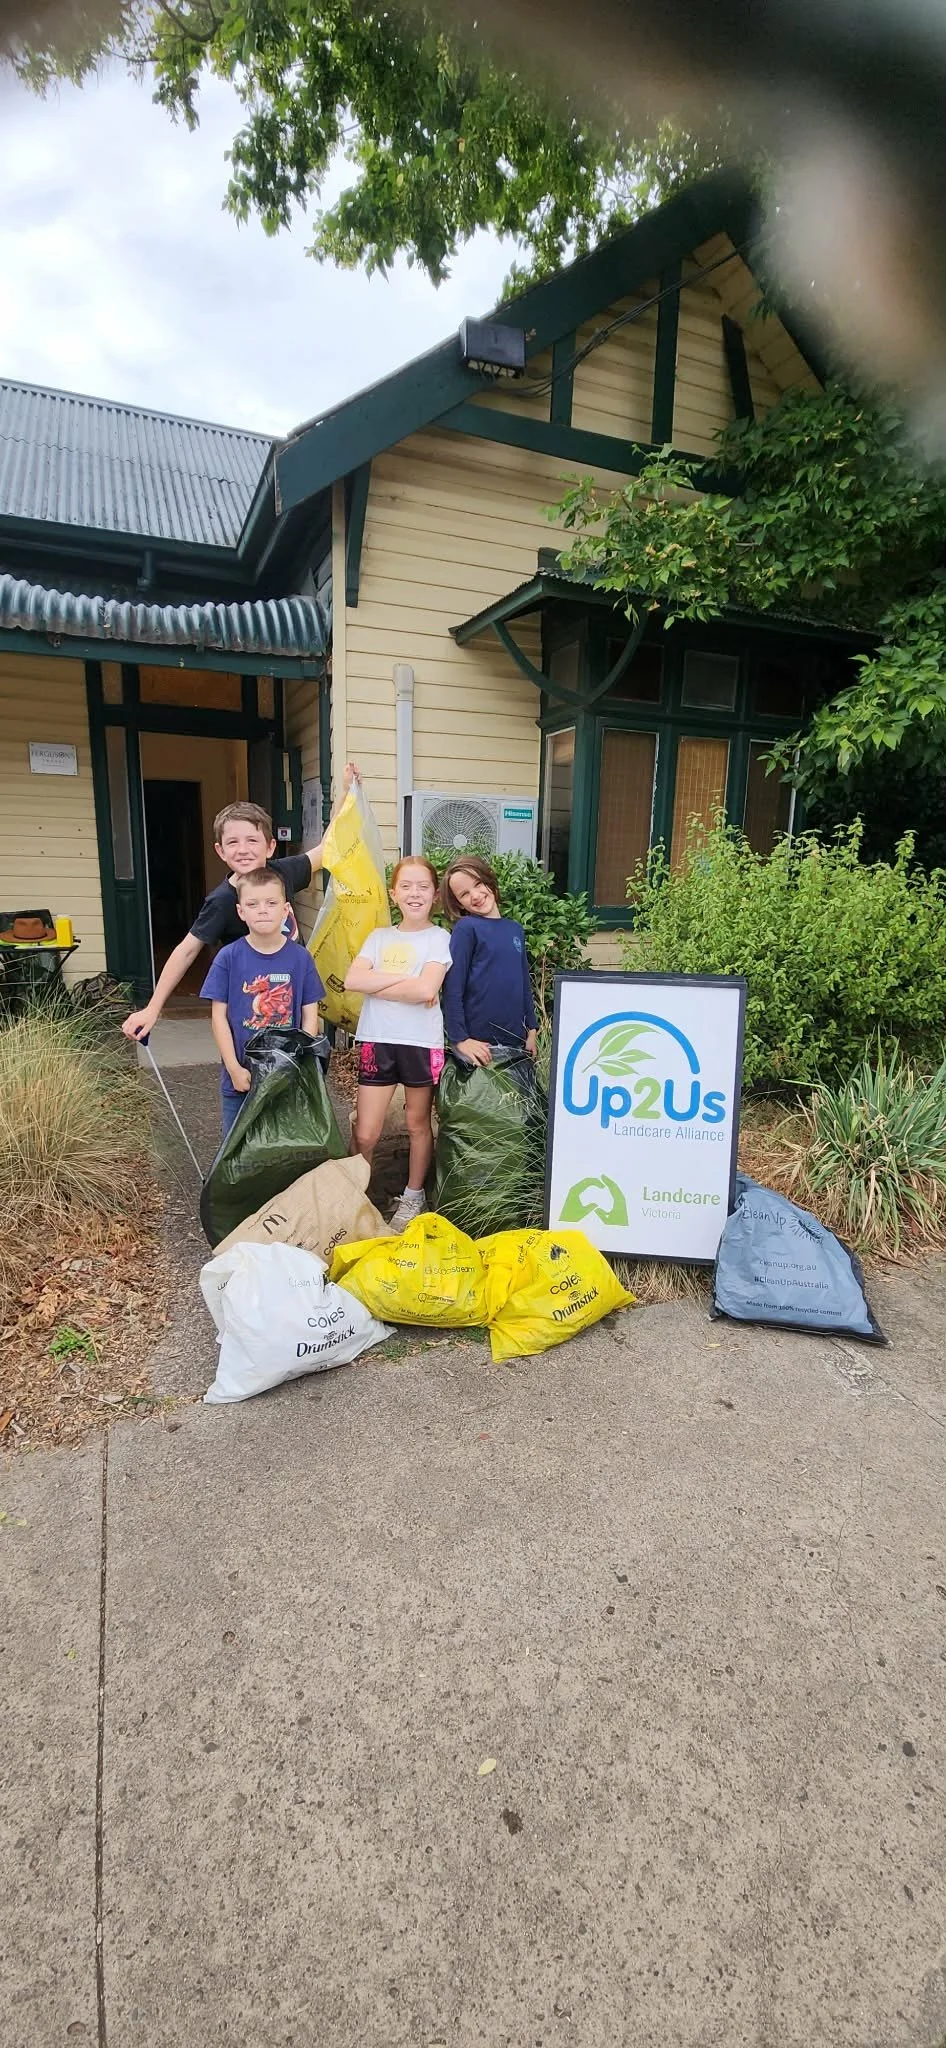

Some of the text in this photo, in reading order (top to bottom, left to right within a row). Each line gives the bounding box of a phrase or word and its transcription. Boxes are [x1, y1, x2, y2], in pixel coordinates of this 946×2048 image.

[504, 810, 532, 818] Hisense
[563, 1074, 726, 1129] Up2Us
[614, 1123, 725, 1142] Landcare Alliance
[643, 1186, 721, 1206] Landcare
[642, 1207, 681, 1220] Victoria
[742, 1206, 771, 1221] Clean
[323, 1227, 348, 1256] coles
[759, 1259, 817, 1271] cleanup.org.au
[549, 1272, 582, 1295] coles
[754, 1276, 829, 1290] #CleanUpAustralia
[552, 1286, 599, 1322] Drumstick
[307, 1306, 346, 1328] coles
[296, 1325, 356, 1358] Drumstick
